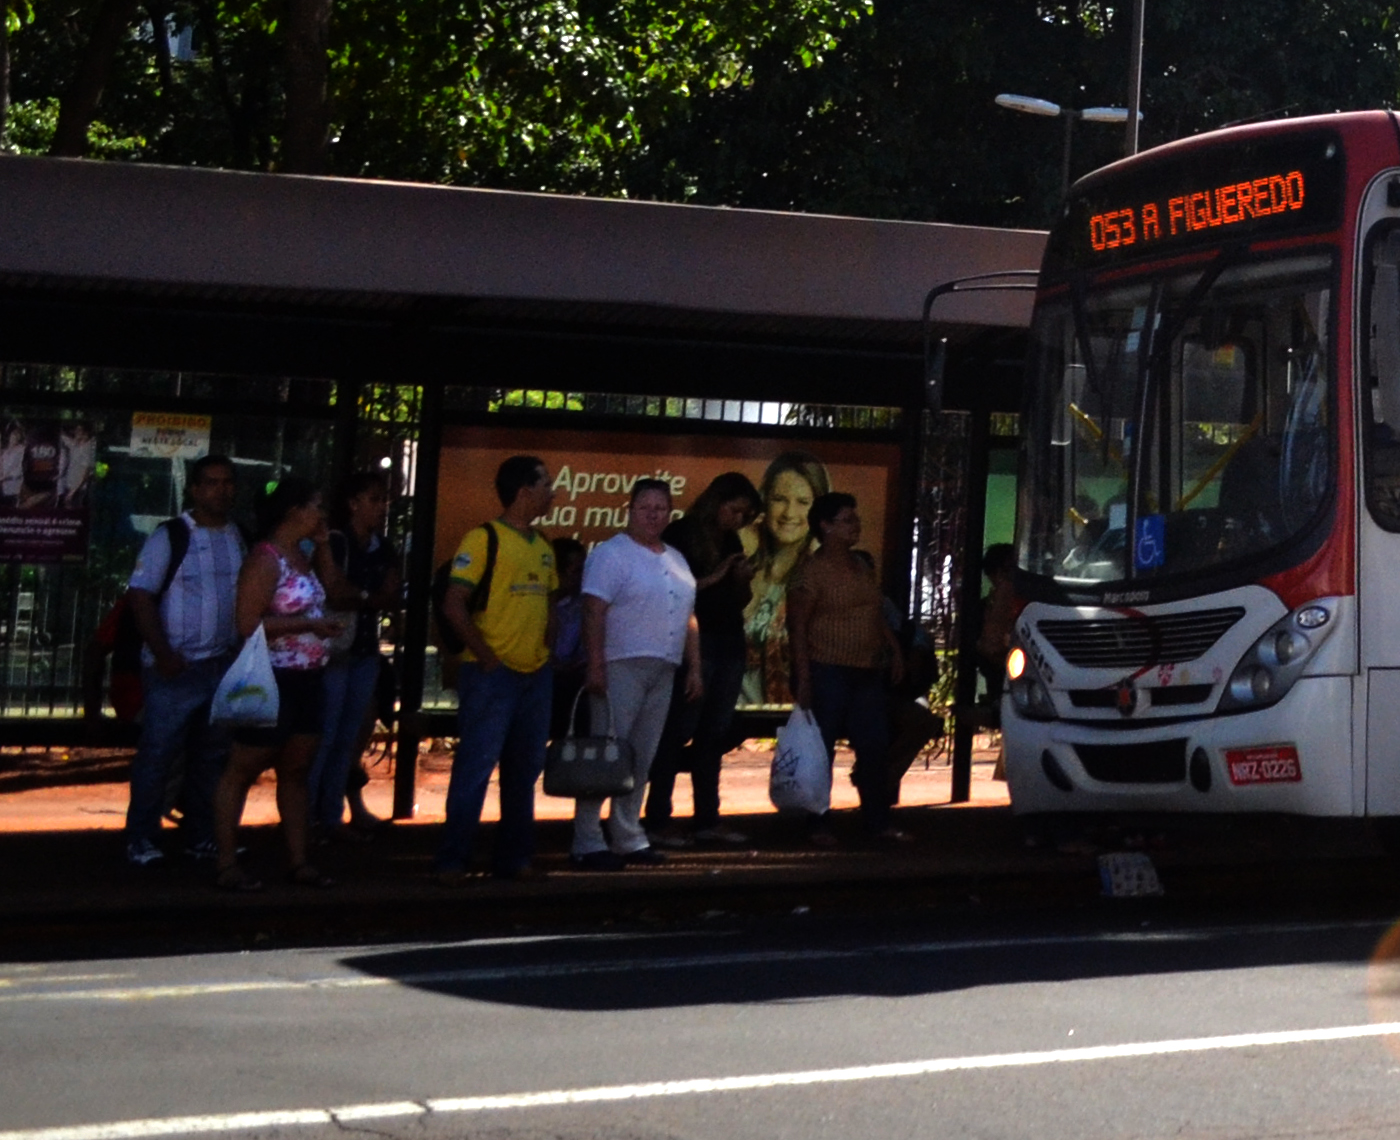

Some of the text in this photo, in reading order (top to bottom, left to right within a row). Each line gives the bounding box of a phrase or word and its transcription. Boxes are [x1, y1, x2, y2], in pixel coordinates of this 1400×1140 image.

[1089, 169, 1306, 251] 053 A FIGUEREDO
